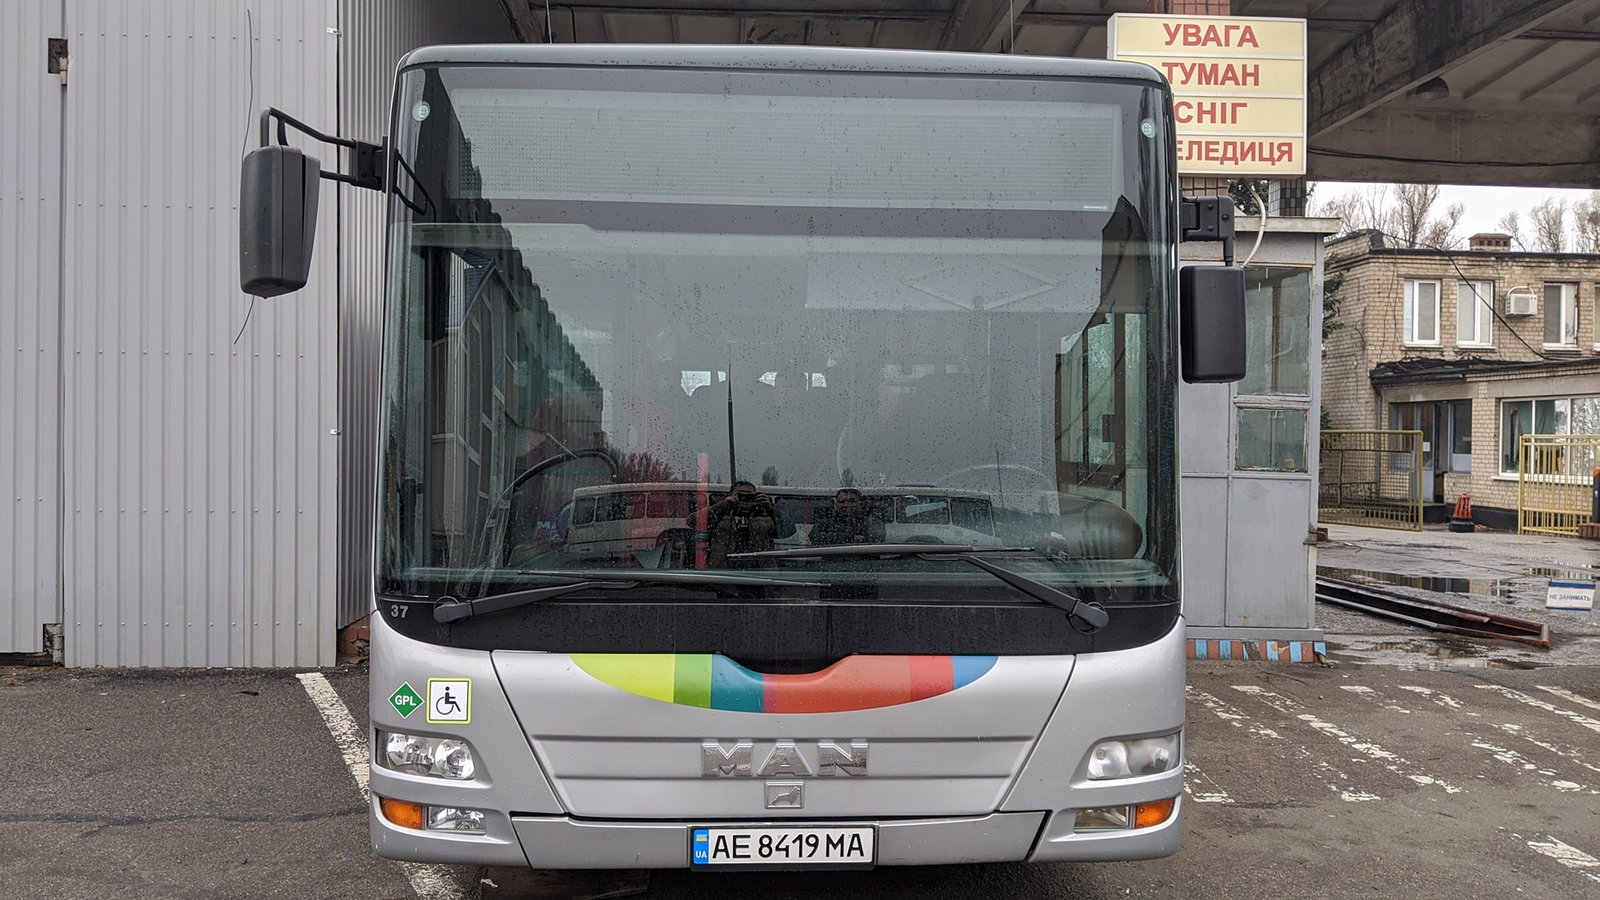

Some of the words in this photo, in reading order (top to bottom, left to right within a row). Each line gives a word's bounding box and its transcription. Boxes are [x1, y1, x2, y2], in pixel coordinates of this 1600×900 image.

[1163, 23, 1259, 48] УВАГА
[1162, 62, 1260, 87] ТУМАН
[1174, 101, 1248, 125] СНІГ
[391, 604, 408, 618] 37
[394, 695, 416, 706] GPL
[701, 739, 869, 777] MAN
[696, 851, 707, 859] UA
[712, 834, 751, 859] AE
[758, 833, 820, 858] 8419
[825, 833, 865, 858] MA
